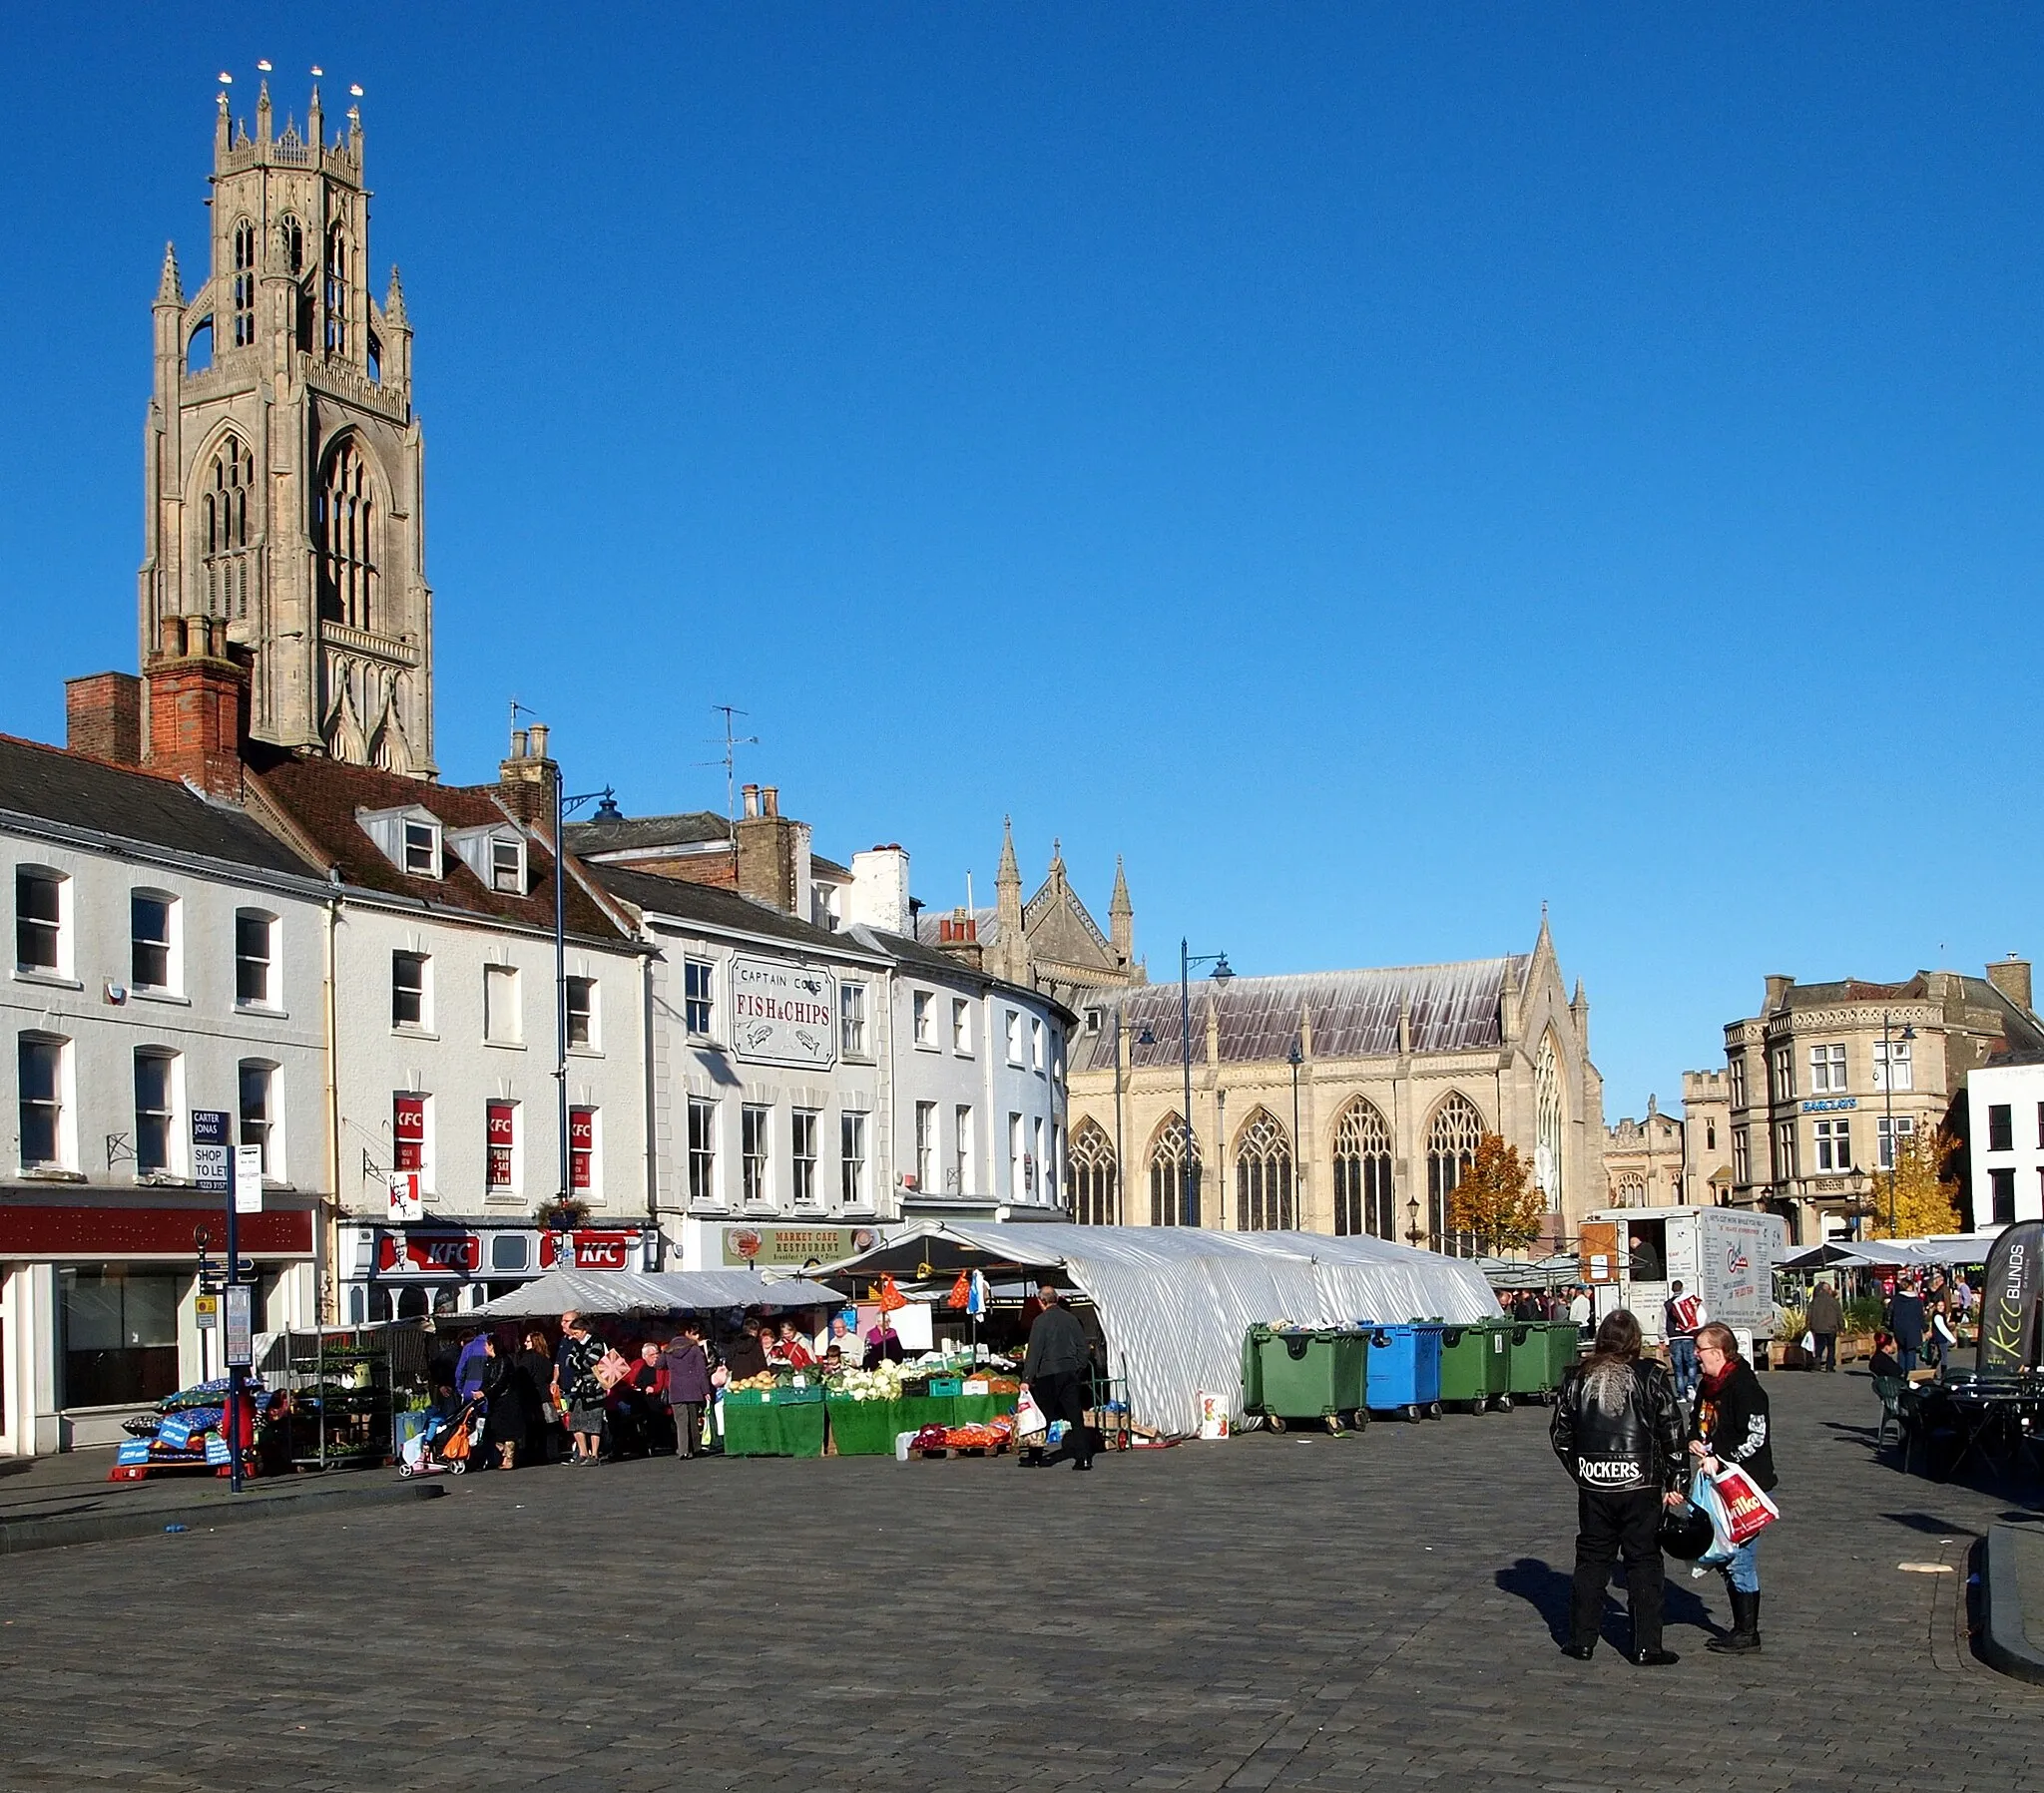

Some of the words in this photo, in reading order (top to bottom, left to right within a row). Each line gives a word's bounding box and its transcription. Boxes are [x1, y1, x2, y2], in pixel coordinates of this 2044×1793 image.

[741, 970, 786, 986] CAPTAIN
[1802, 1098, 1856, 1112] BARCLAYS
[194, 1113, 220, 1122] CARTER
[395, 1111, 422, 1126] KFC
[194, 1124, 218, 1134] JONAS
[488, 1119, 511, 1132] KFC
[571, 1123, 591, 1136] KFC
[195, 1149, 222, 1160] SHOP
[490, 1148, 509, 1160] PEN
[196, 1164, 210, 1176] TO
[212, 1165, 228, 1176] LET
[775, 1232, 812, 1241] MARKET
[815, 1232, 838, 1241] CAFE
[427, 1242, 469, 1263] KFC
[580, 1241, 619, 1262] KFC
[776, 1243, 839, 1252] RESTAURANT
[1988, 1297, 2022, 1358] KCC
[2006, 1244, 2025, 1300] BLINDS
[1578, 1457, 1641, 1481] ROCKERS
